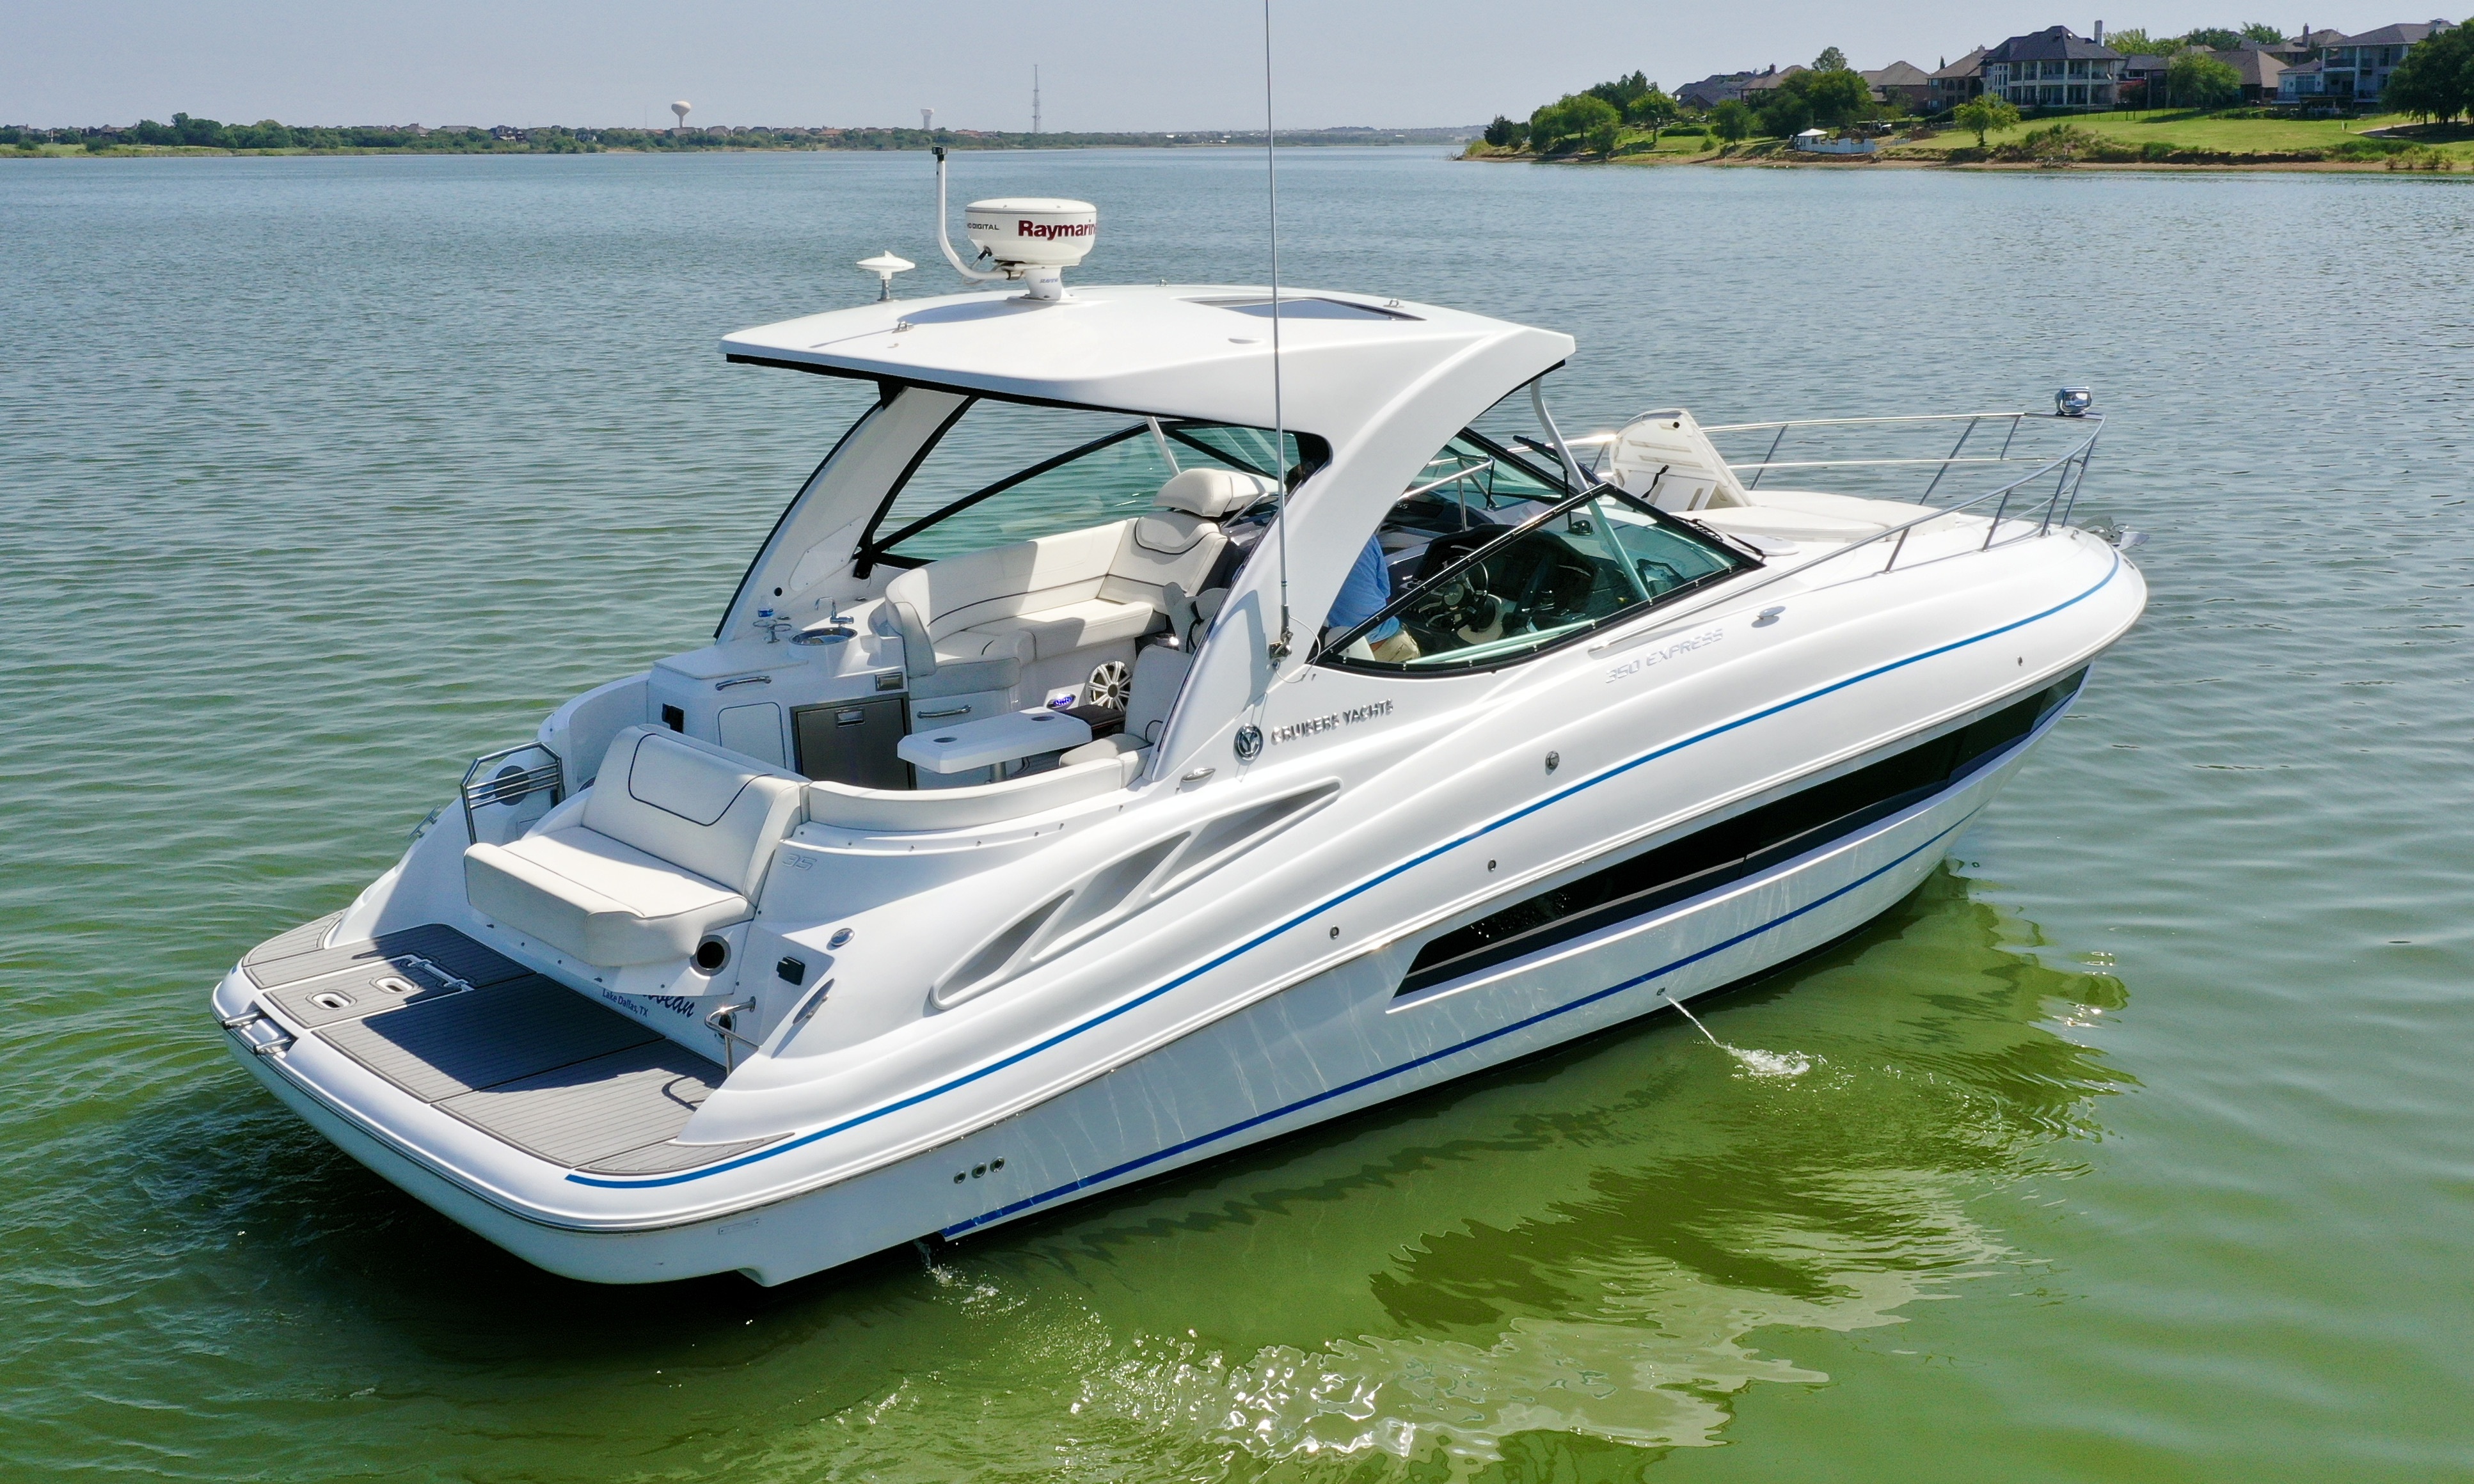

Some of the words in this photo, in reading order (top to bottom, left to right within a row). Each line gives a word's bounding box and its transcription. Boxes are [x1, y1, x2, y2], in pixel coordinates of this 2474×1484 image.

[1018, 219, 1096, 241] Raymarin
[1605, 659, 1640, 683] 350
[1645, 628, 1724, 666] EXPRESS
[1271, 712, 1340, 743] CRUISERS
[1342, 698, 1393, 725] YACHTS
[782, 853, 817, 871] 35
[602, 988, 617, 1003] Lake
[617, 995, 638, 1014] Dallas,
[639, 1005, 649, 1018] TX
